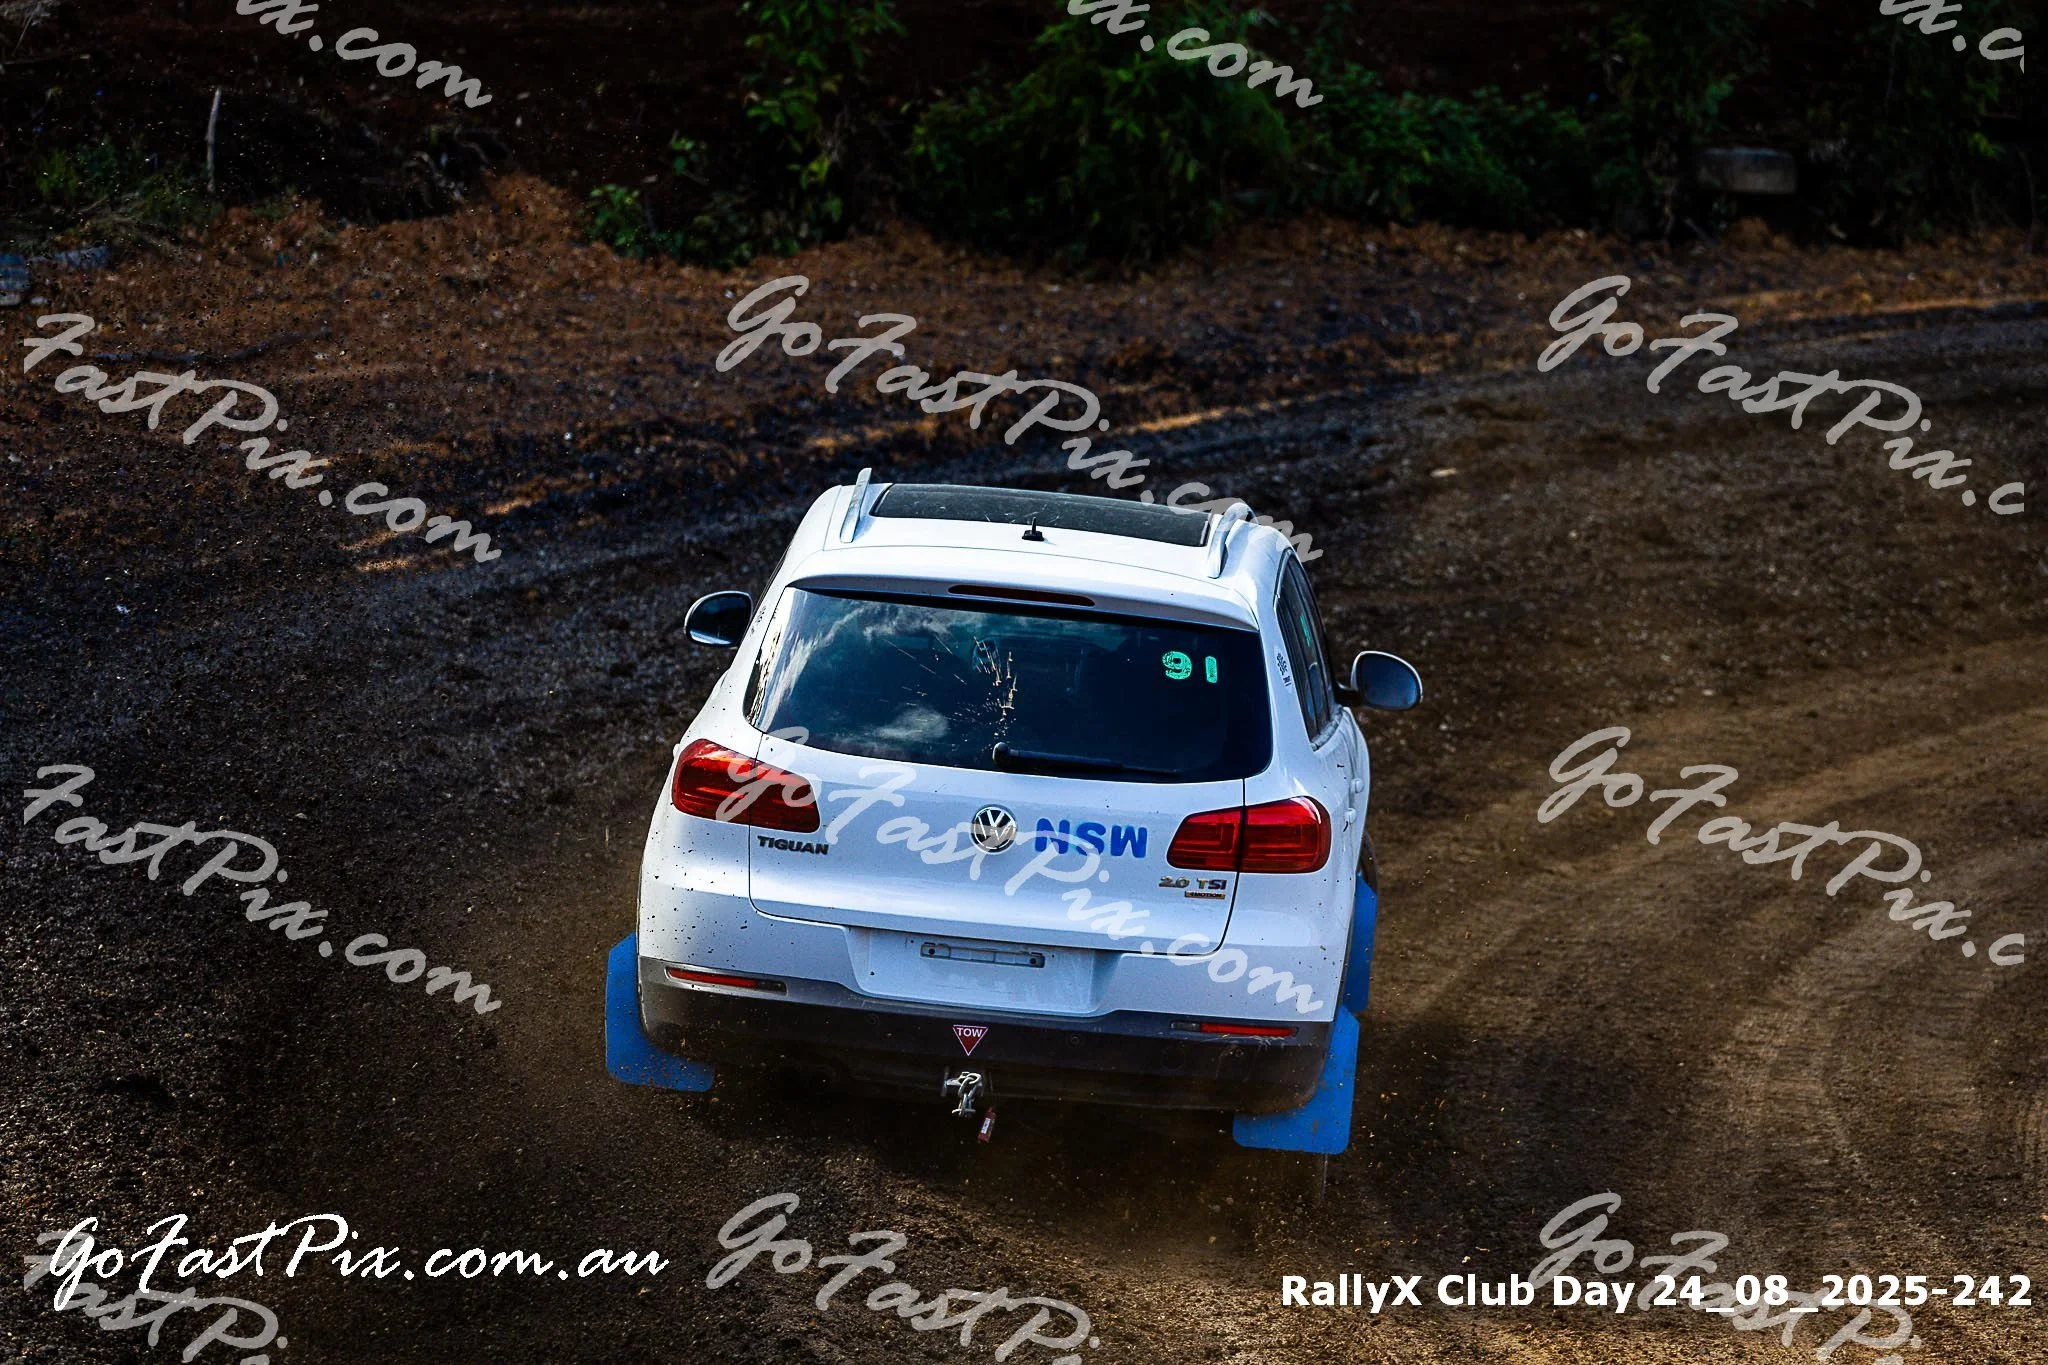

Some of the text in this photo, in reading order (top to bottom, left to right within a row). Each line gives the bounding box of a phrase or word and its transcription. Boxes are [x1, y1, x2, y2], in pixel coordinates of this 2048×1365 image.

[1161, 650, 1219, 684] 91
[757, 835, 830, 856] TIGUAN
[1034, 817, 1148, 859] NSW
[1158, 875, 1228, 890] 2.0 TSI
[956, 1027, 983, 1038] TOW
